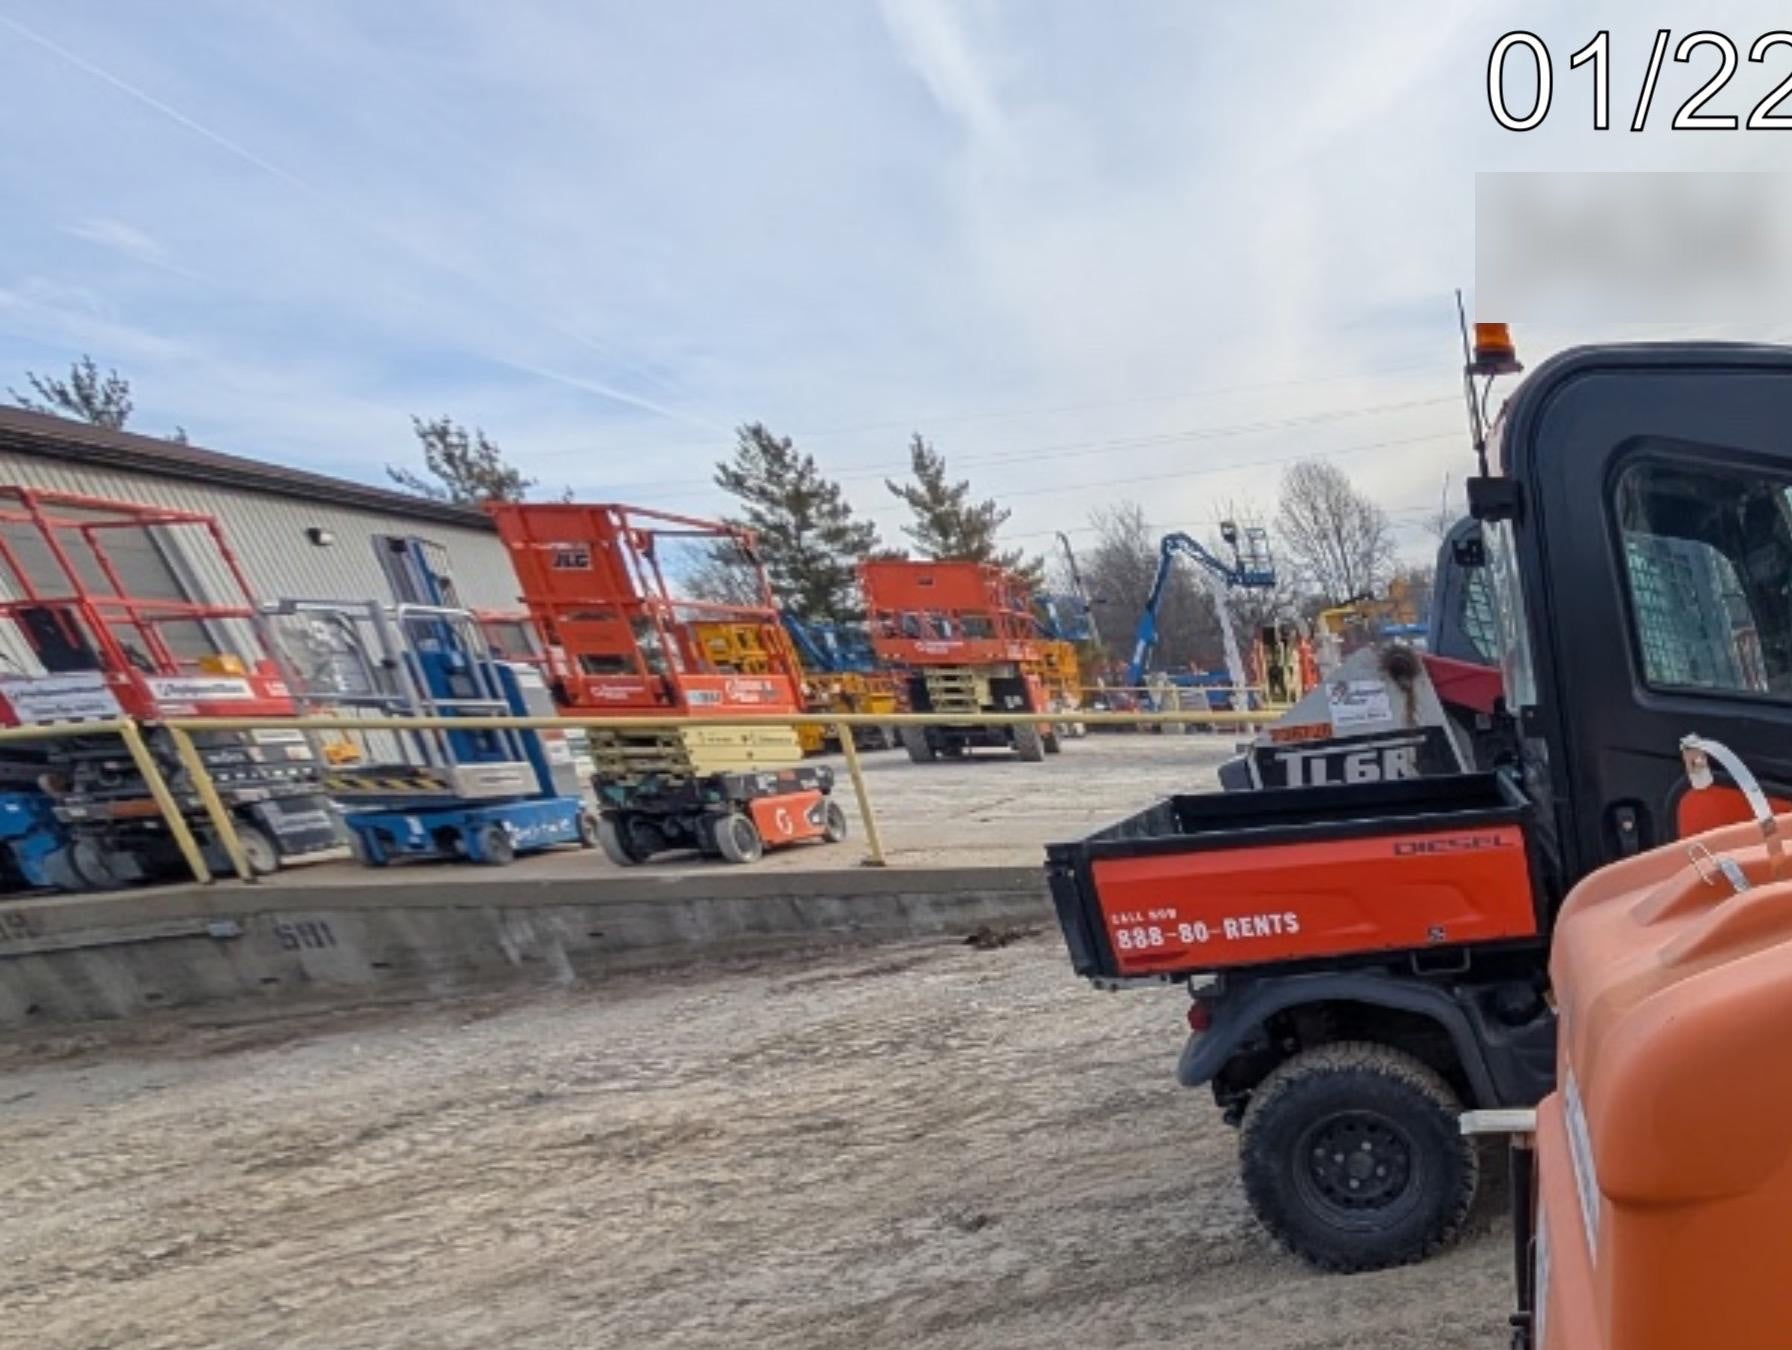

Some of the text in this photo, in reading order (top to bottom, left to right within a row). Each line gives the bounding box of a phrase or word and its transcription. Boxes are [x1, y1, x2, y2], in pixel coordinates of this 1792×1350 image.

[1393, 834, 1517, 856] DIESEL
[1111, 907, 1178, 925] CALL NOW
[1116, 911, 1300, 950] 888-80-RENTS
